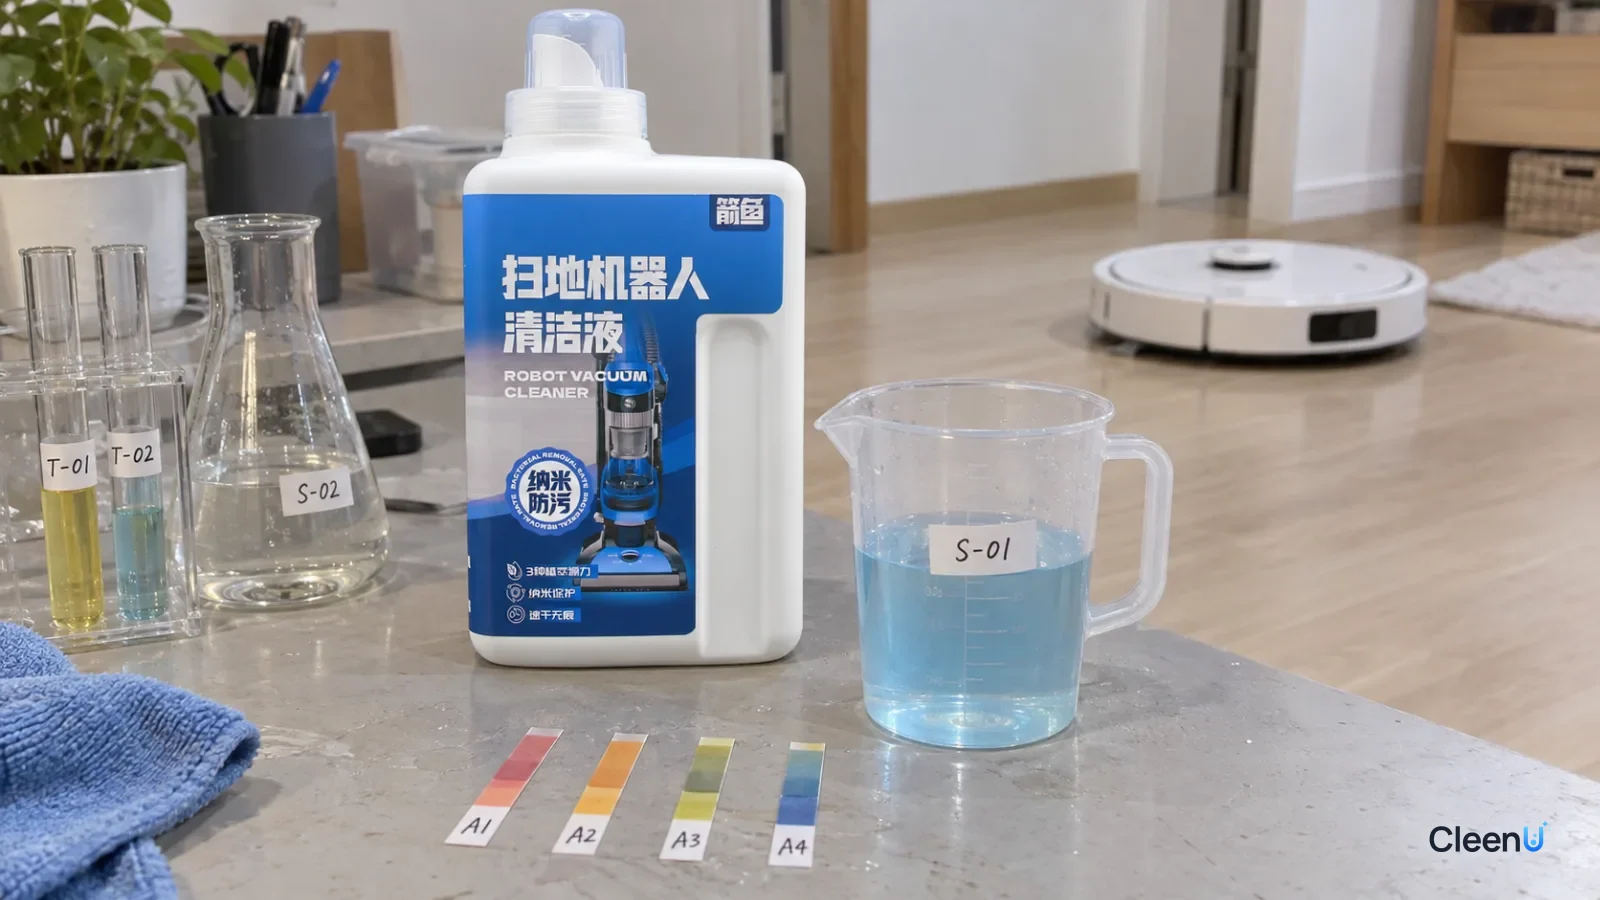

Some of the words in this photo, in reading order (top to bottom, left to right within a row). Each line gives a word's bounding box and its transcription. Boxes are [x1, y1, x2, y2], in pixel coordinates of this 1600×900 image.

[716, 197, 764, 225] 箭鱼
[502, 255, 710, 300] 扫地机器人
[503, 311, 623, 353] 清洁液
[503, 370, 567, 382] ROBOT
[570, 370, 648, 382] VACUUM
[504, 387, 589, 399] CLEANER
[47, 455, 90, 477] T-01
[111, 445, 155, 465] T-02
[526, 469, 572, 492] 纳米
[297, 480, 341, 504] S-02
[528, 492, 572, 516] 防污
[955, 537, 1011, 562] S-01
[461, 817, 492, 835] A1
[565, 826, 597, 844] A2
[671, 833, 701, 849] A3
[778, 839, 809, 856] A4
